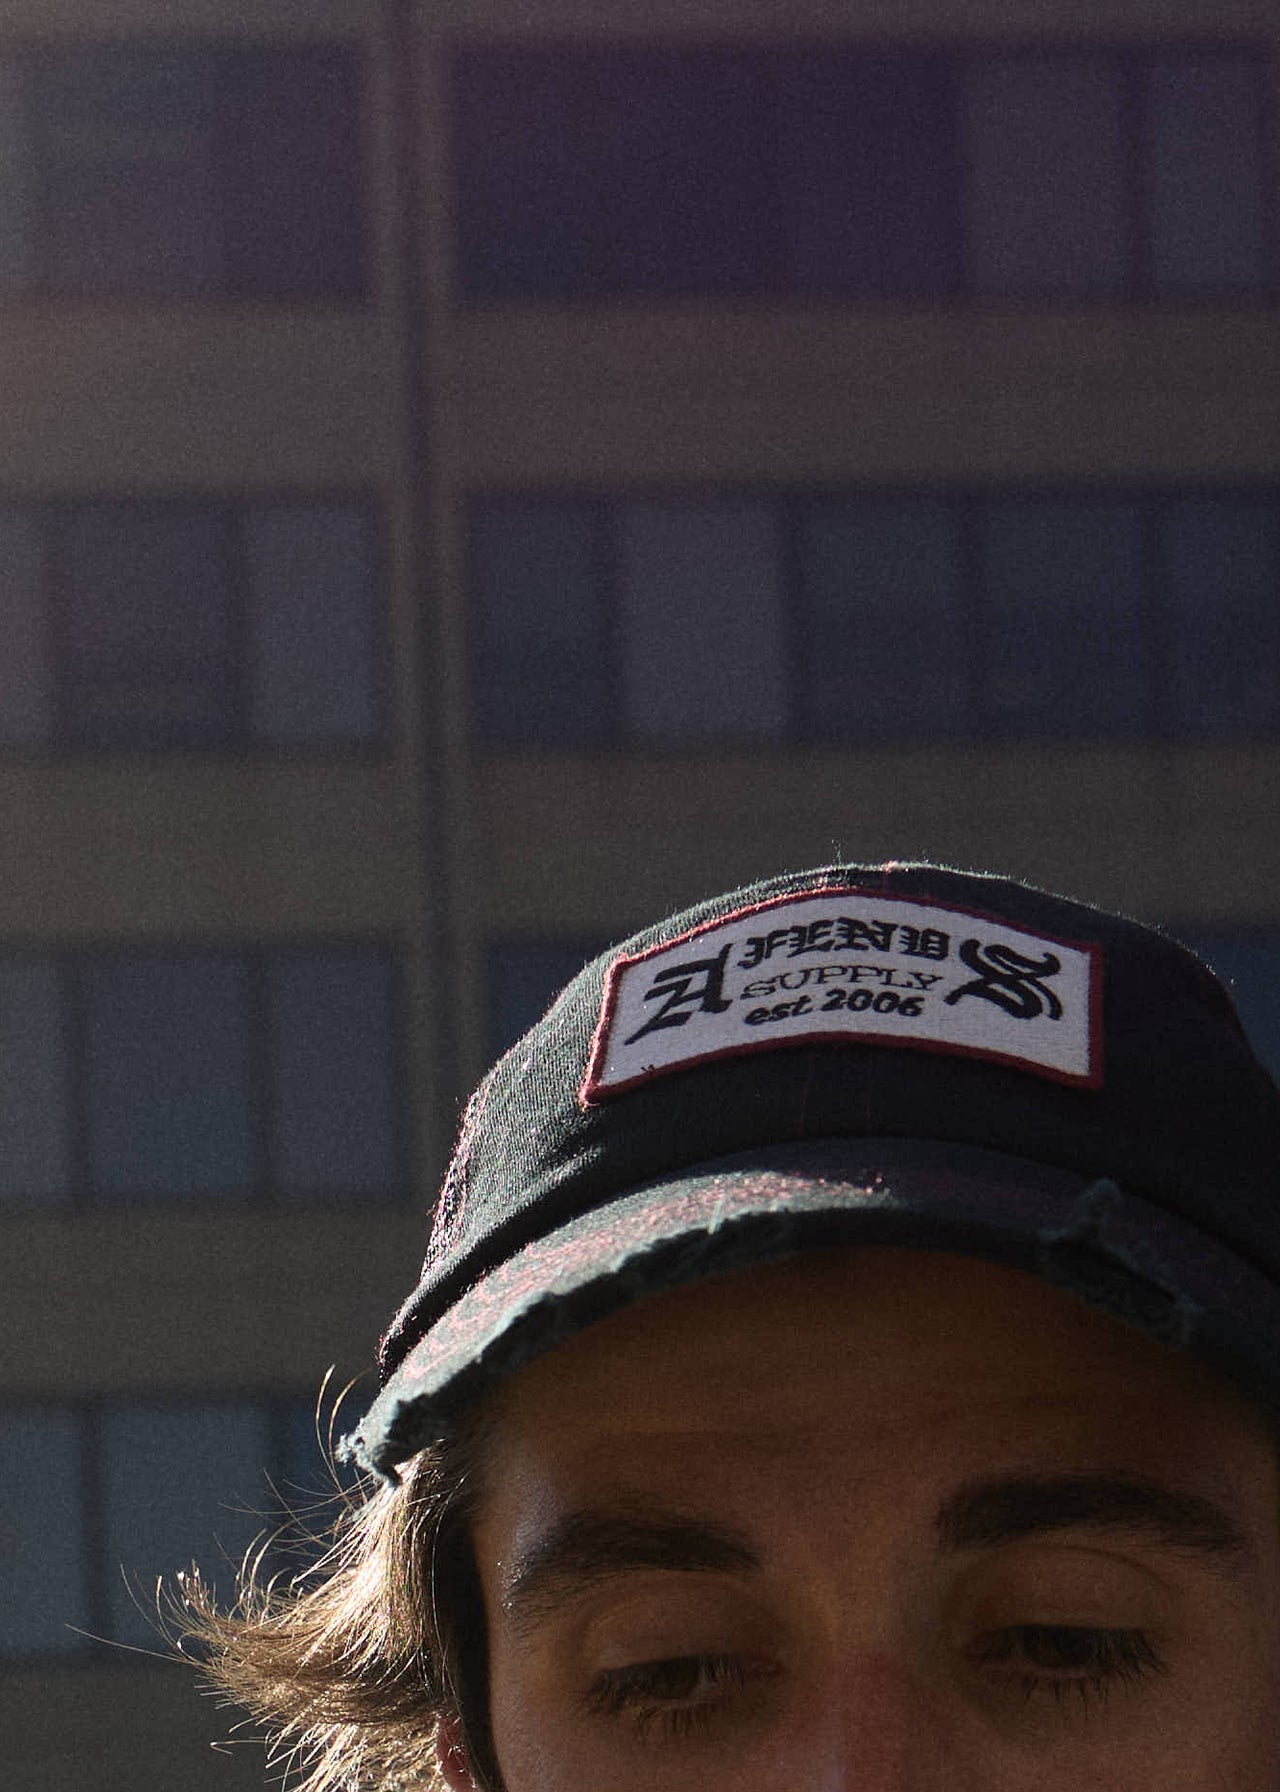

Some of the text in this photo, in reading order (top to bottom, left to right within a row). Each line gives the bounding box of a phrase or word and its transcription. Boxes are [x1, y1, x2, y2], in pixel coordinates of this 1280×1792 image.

[624, 916, 1063, 1045] AFENDS
[740, 965, 943, 1000] SUPPLY
[744, 988, 925, 1026] est 2006
